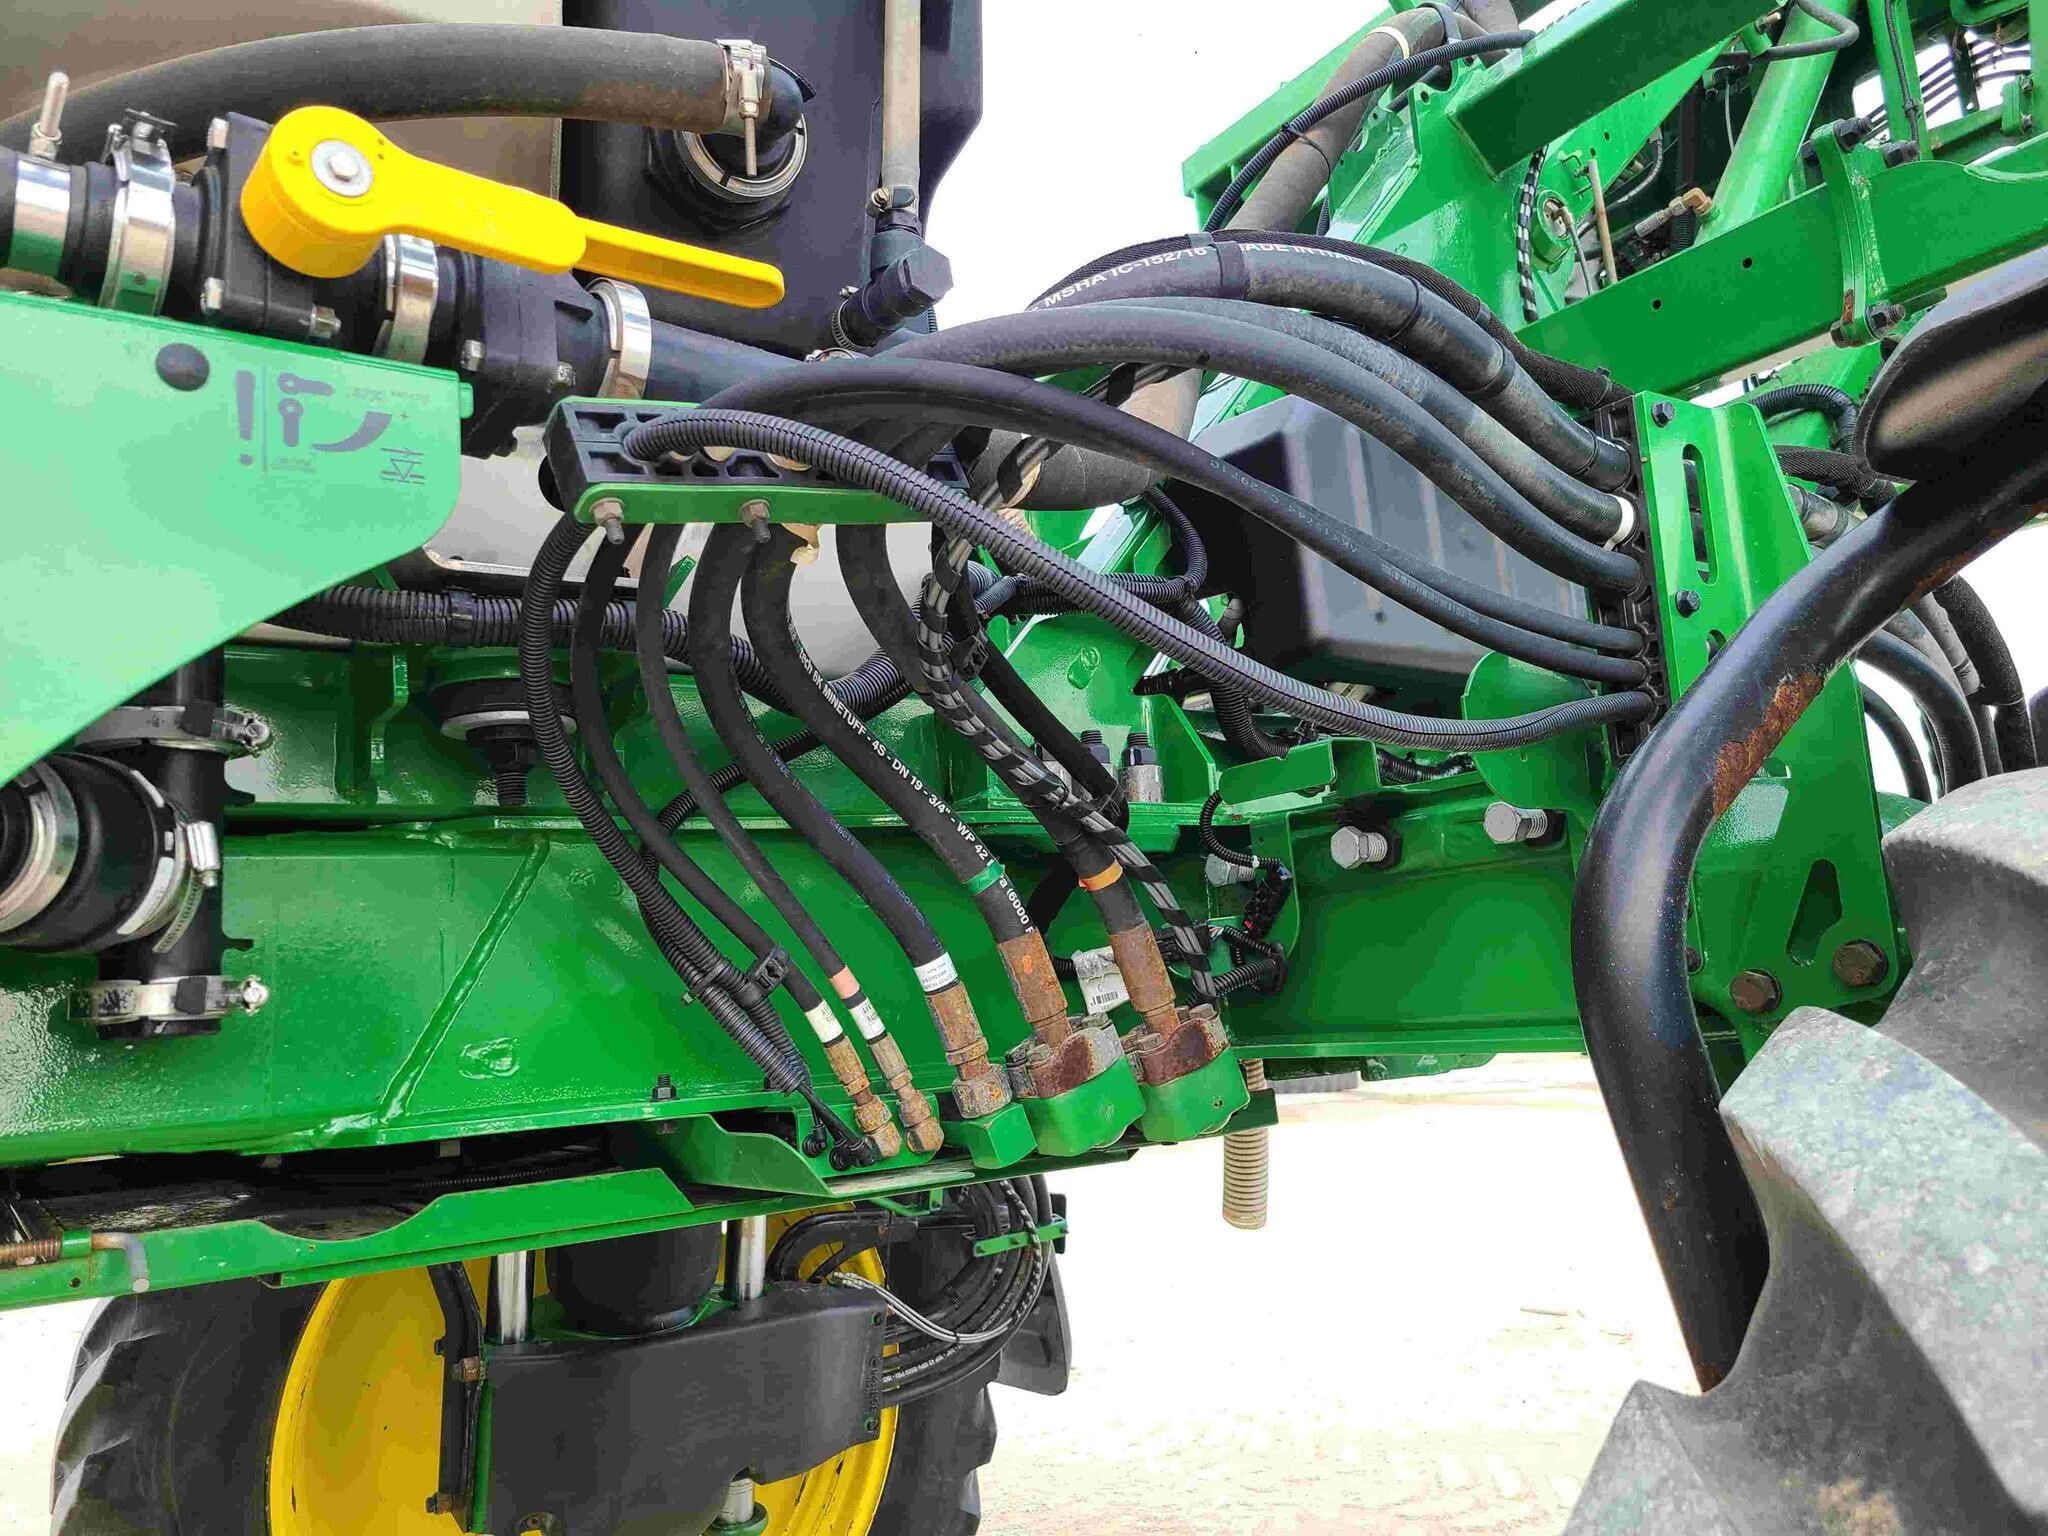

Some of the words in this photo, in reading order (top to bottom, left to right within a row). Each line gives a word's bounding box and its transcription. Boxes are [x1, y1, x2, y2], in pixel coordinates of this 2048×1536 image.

[1044, 273, 1107, 307] MSHA
[1109, 246, 1208, 278] IC-152/16
[812, 670, 825, 690] 6K
[822, 682, 868, 736] MINETUFF
[872, 739, 887, 757] 4S
[891, 758, 910, 779] DN
[909, 775, 924, 791] 19
[955, 821, 976, 843] WP
[974, 843, 990, 861] 42
[1006, 888, 1030, 925] (6000
